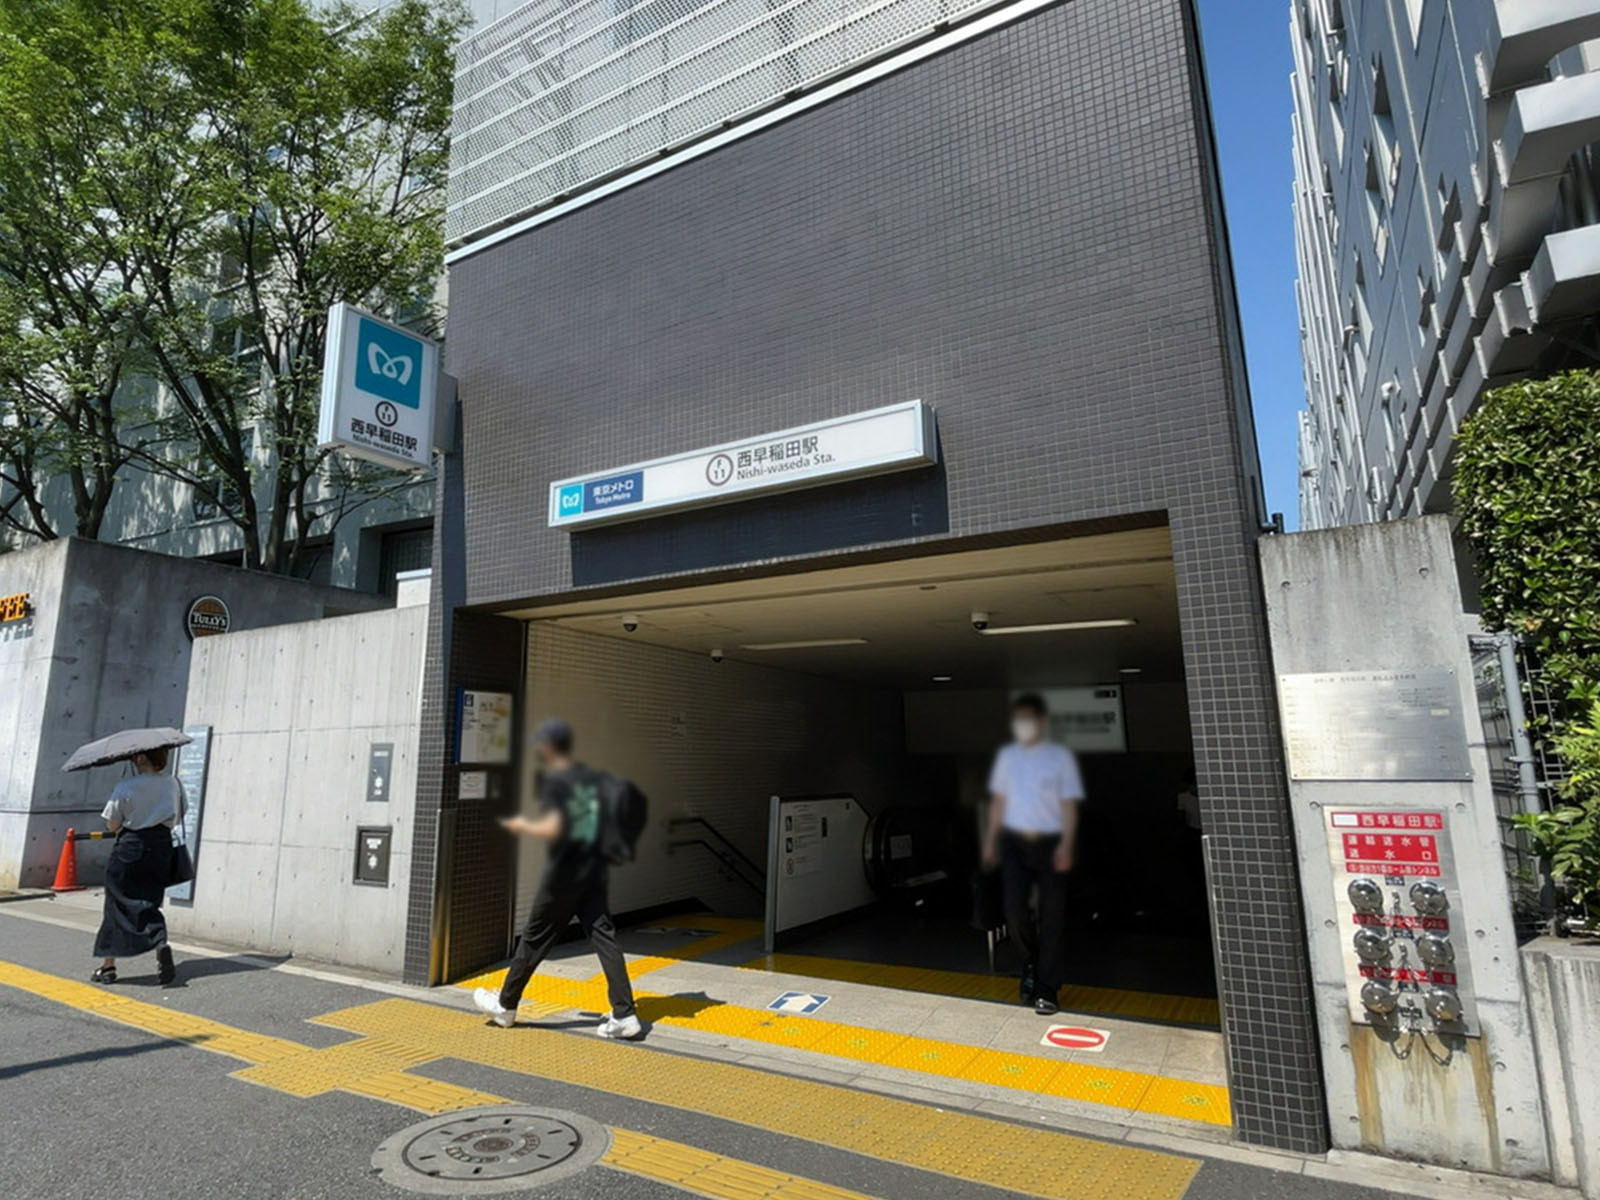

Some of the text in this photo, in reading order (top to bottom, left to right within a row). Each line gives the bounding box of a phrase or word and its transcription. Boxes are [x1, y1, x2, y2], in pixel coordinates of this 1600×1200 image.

[351, 417, 418, 452] 西早稲田駅
[736, 435, 819, 469] 西早稲田駅
[717, 459, 723, 469] F
[736, 453, 836, 480] Nishi-waseda Sta.
[714, 469, 725, 480] 11
[593, 479, 635, 497] 東京メトロ
[1361, 814, 1439, 828] 西早稲田駅
[1349, 848, 1432, 860] 送水口
